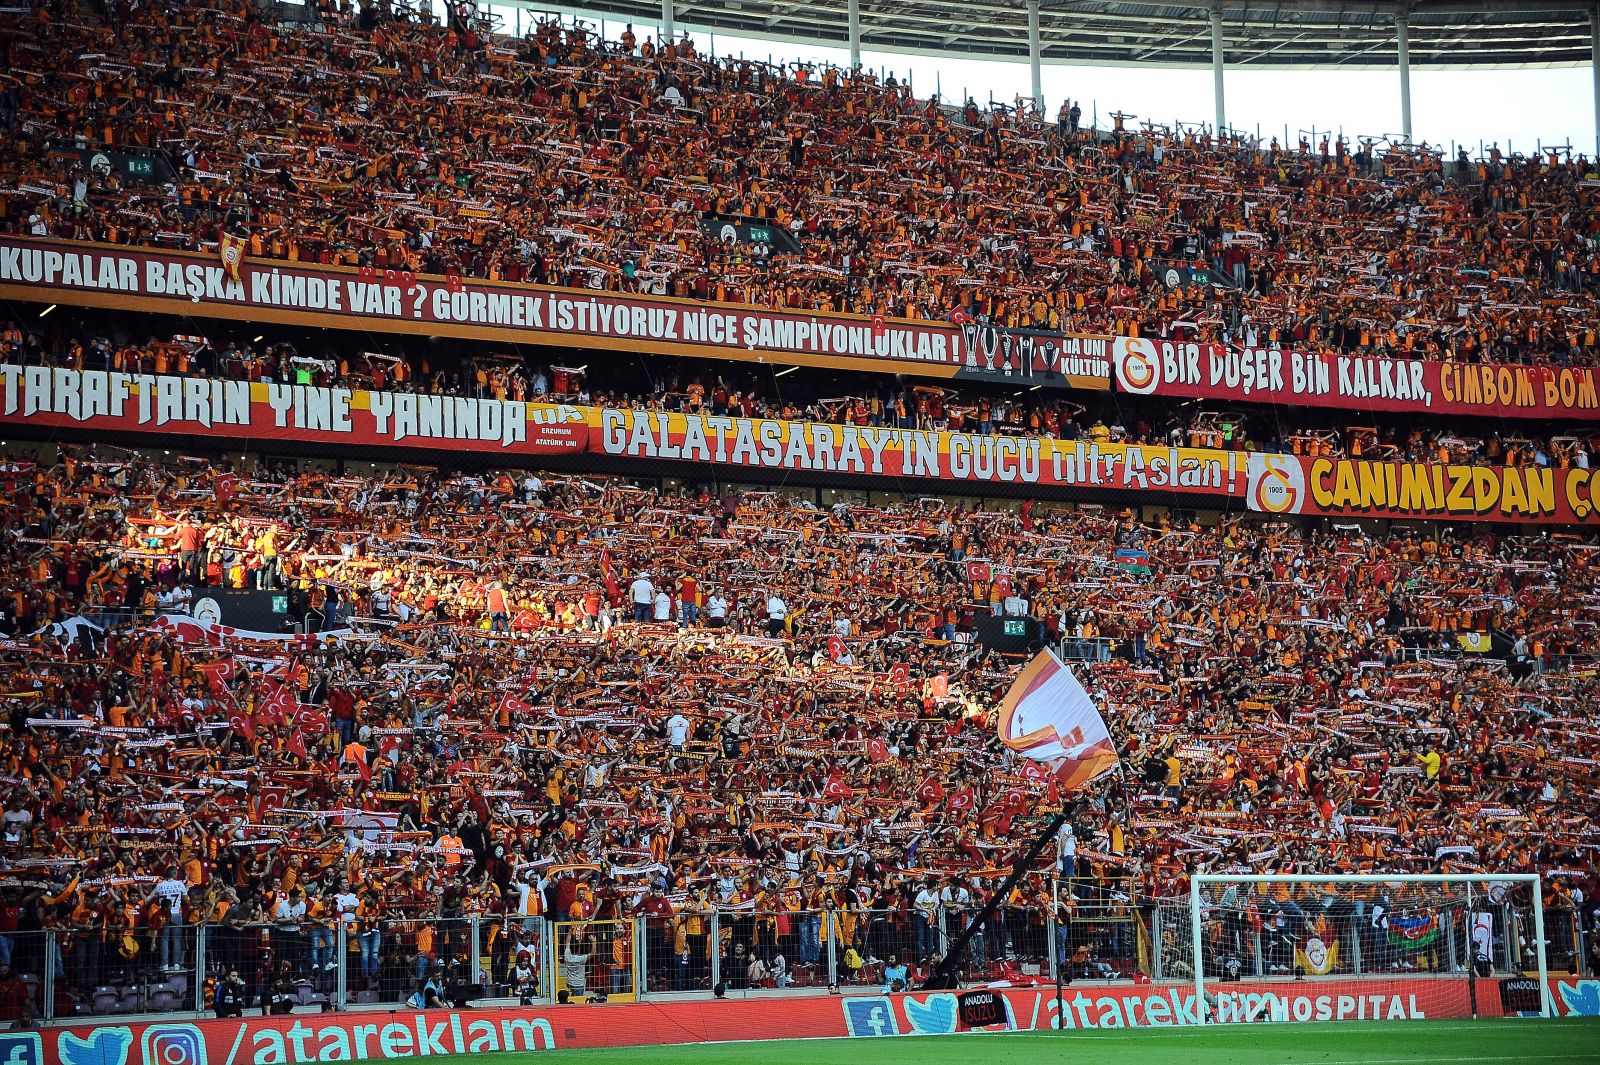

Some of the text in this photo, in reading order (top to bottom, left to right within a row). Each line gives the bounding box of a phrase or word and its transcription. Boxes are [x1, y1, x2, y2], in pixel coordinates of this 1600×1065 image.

[1, 247, 960, 362] KUPALAR BAŞKA KİMDE VAR ? GÖRMEK İSTİYORUZ NİCE ŞAMPİYONLUKLAR !
[1083, 339, 1106, 357] UNI
[1060, 355, 1110, 377] KÜLTÜR
[1162, 342, 1599, 409] BİR DÜŞER BİN KALKAR, CİMBOM BOM
[1, 364, 527, 447] TARAFTARIN YINE YANINDA
[541, 427, 572, 435] ERZURUM
[535, 438, 563, 446] ATATÜRK
[602, 408, 940, 477] GALATASARAY'IN
[1268, 486, 1283, 494] 1905
[1310, 458, 1556, 515] CANIMIZDAN
[1506, 980, 1540, 991] ANADOLU
[964, 993, 993, 1006] ANADOLU
[965, 1004, 996, 1022] ISUZU
